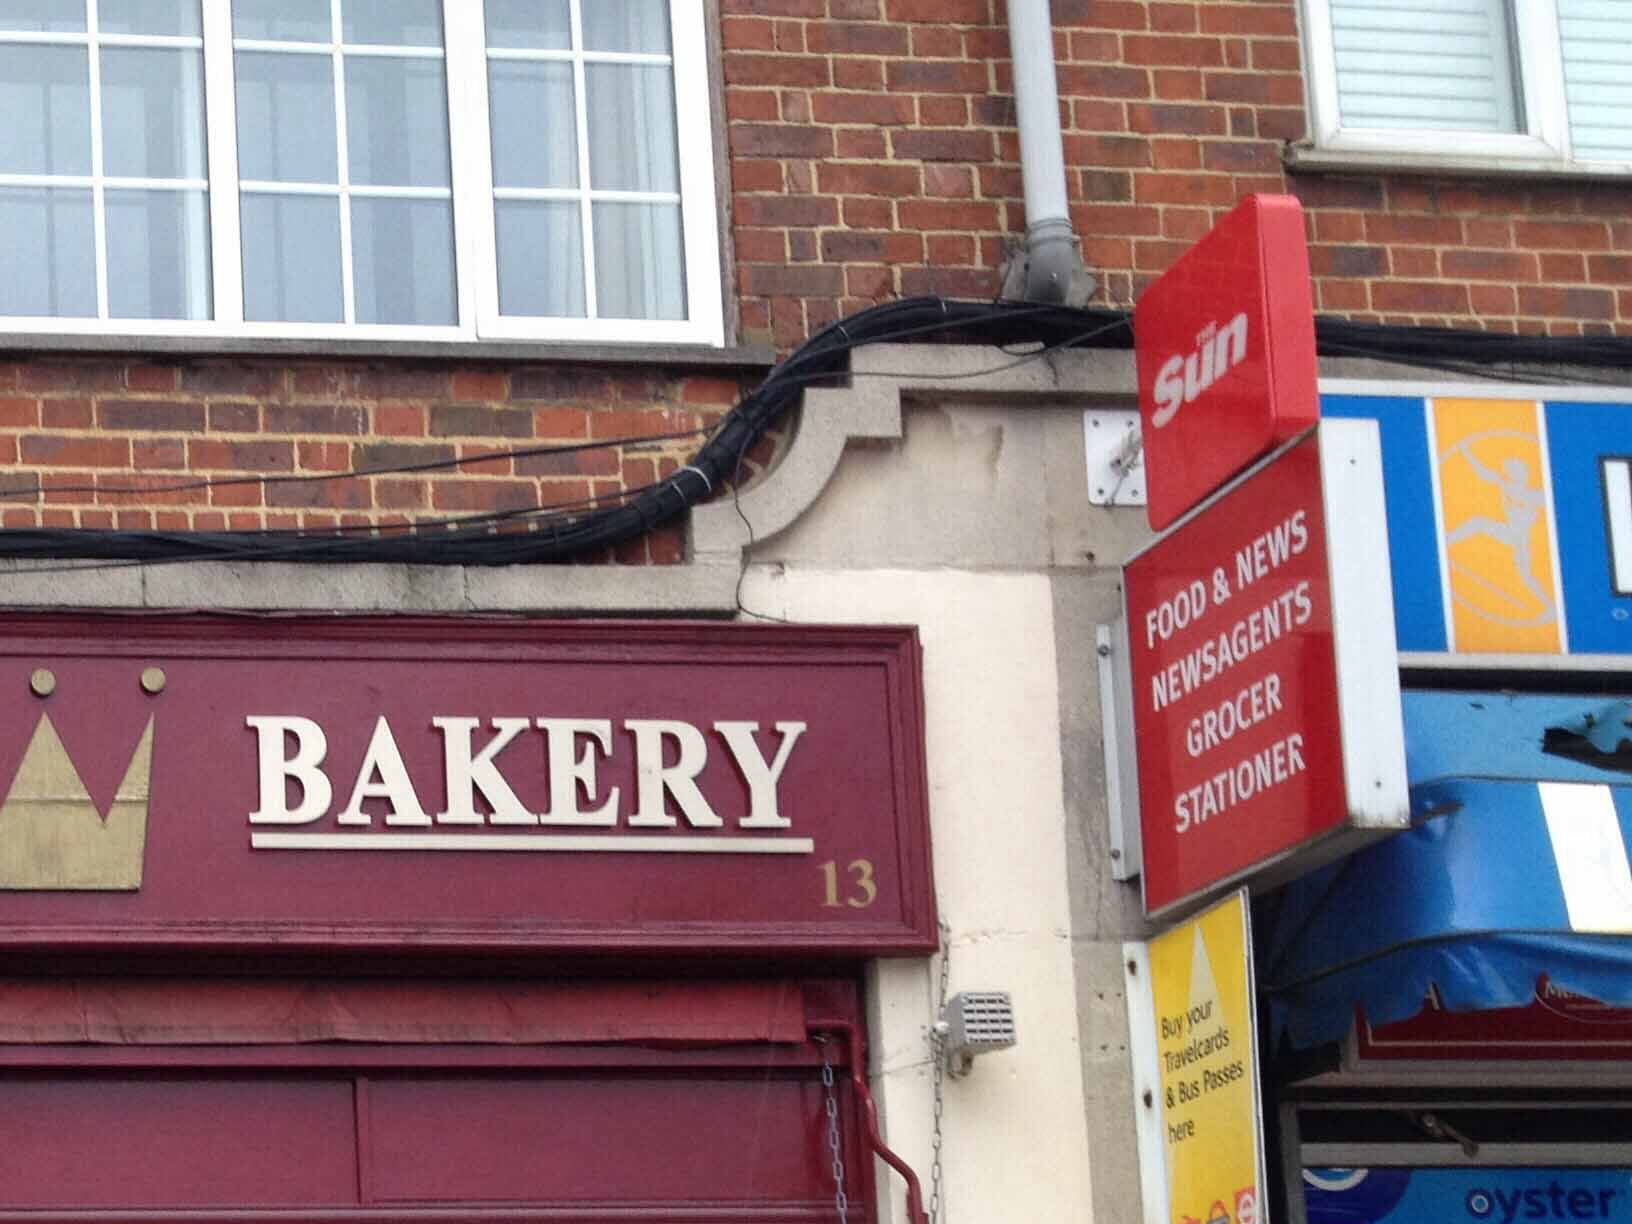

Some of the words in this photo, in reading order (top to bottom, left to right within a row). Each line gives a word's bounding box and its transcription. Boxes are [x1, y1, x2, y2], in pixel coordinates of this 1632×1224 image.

[1151, 311, 1249, 428] Sun
[1145, 580, 1207, 649] FOOD
[1212, 567, 1232, 605] &
[1235, 510, 1309, 590] NEWS
[1151, 580, 1313, 713] NEWSAGENTS
[1186, 672, 1283, 757] GROCER
[246, 714, 808, 829] BAKERY
[1174, 733, 1306, 834] STATIONER
[819, 858, 878, 909] 13
[1161, 1015, 1183, 1040] Buy
[1186, 999, 1213, 1034] your
[1163, 1024, 1230, 1074] Travelcards
[1166, 1085, 1176, 1110] &
[1178, 1080, 1201, 1104] Bus
[1203, 1059, 1245, 1094] Passes
[1168, 1119, 1196, 1145] here
